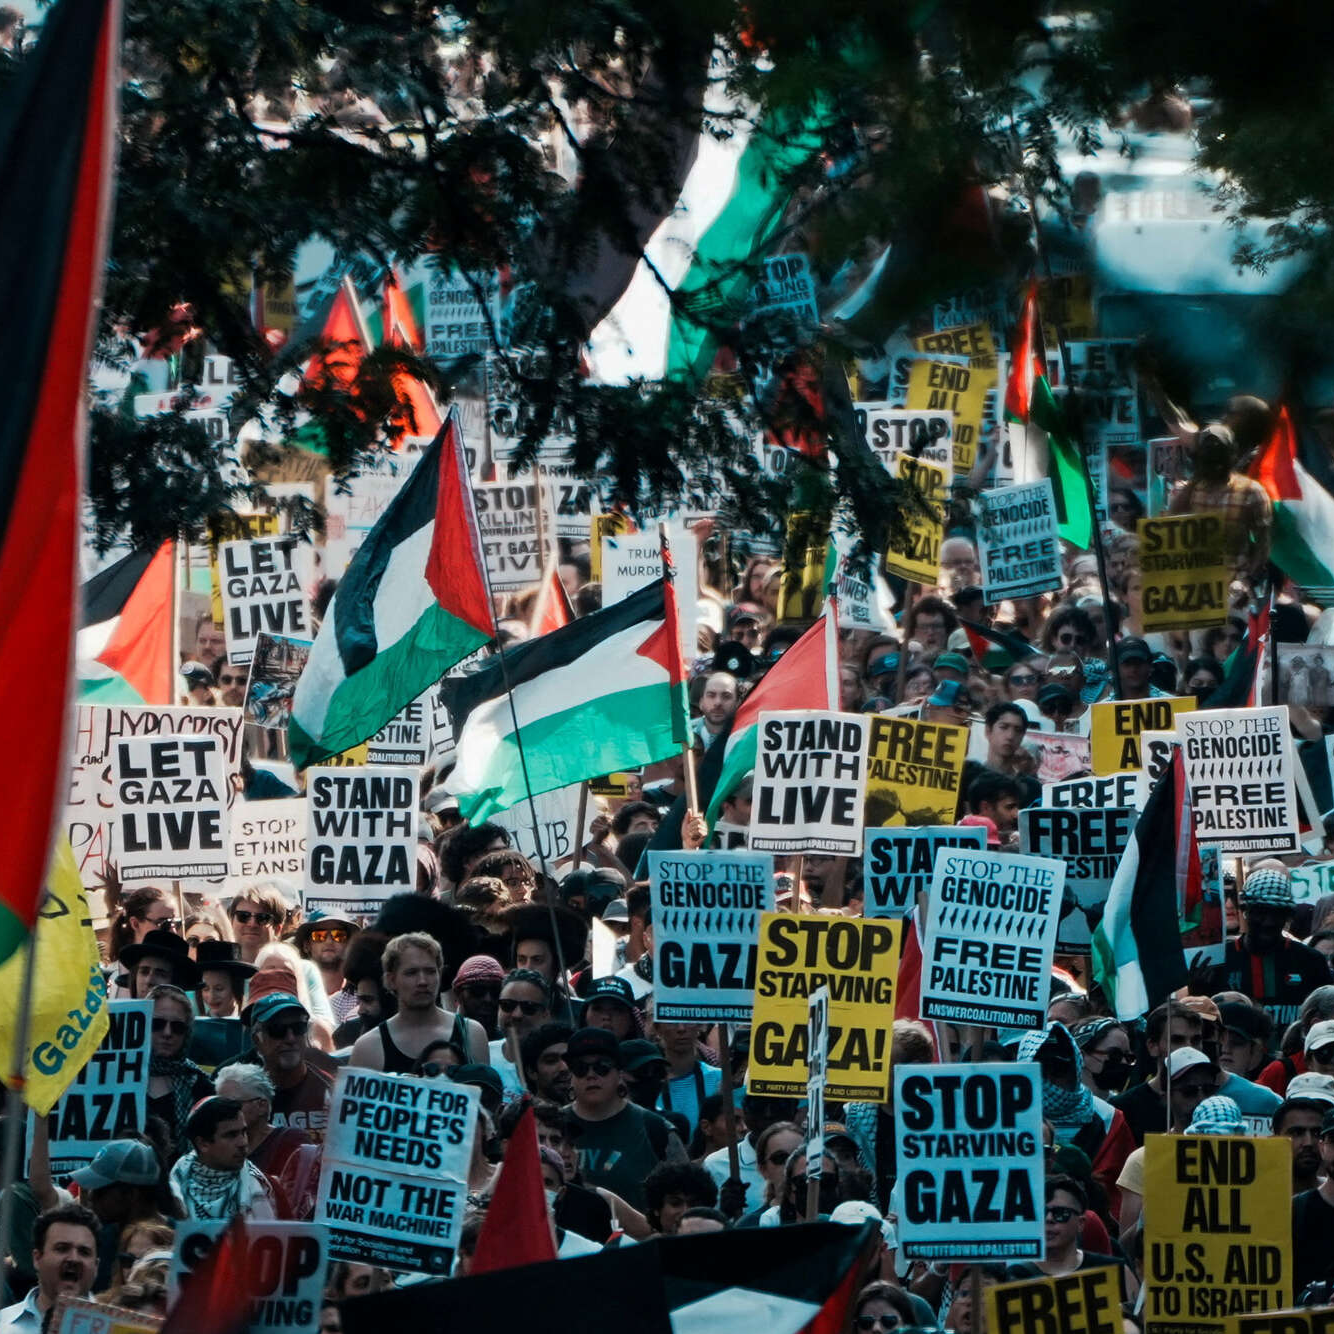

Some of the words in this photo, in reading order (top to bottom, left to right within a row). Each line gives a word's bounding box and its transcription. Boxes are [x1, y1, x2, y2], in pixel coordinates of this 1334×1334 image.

[929, 363, 970, 392] END
[872, 418, 947, 449] STOP
[983, 499, 1049, 528] GENOCIDE
[1143, 516, 1218, 551] STOP
[225, 542, 298, 576] LET
[987, 538, 1055, 566] FREE
[227, 574, 302, 598] GAZA
[988, 558, 1056, 585] PALESTINE
[1143, 584, 1225, 615] GAZA!
[230, 601, 305, 640] LIVE
[1115, 702, 1172, 735] END
[1186, 719, 1234, 736] STOP
[1240, 717, 1281, 733] THE
[763, 722, 863, 753] STAND
[872, 719, 957, 771] FREE
[1187, 733, 1282, 759] GENOCIDE
[118, 741, 216, 779] LET
[763, 752, 861, 780] WITH
[119, 780, 219, 804] GAZA
[313, 776, 413, 809] STAND
[759, 786, 857, 826] LIVE
[1191, 782, 1286, 807] FREE
[122, 811, 223, 852] LIVE
[242, 820, 296, 835] STOP
[313, 811, 412, 838] WITH
[1195, 807, 1288, 831] PALESTINE
[310, 845, 411, 885] GAZA
[659, 860, 713, 883] STOP
[720, 863, 765, 882] THE
[944, 858, 1003, 879] STOP
[1008, 865, 1054, 887] THE
[660, 882, 766, 908] GENOCIDE
[941, 876, 1051, 915] GENOCIDE
[767, 918, 893, 971] STOP
[933, 936, 1043, 973] FREE
[759, 971, 893, 1004] STARVING
[929, 966, 1041, 1002] PALESTINE
[927, 1004, 1039, 1027] ANSWERCOALITION.ORG
[754, 1021, 887, 1073] GAZA!
[344, 1075, 423, 1107] MONEY
[428, 1089, 469, 1116] FOR
[901, 1075, 1034, 1130] STOP
[339, 1099, 464, 1144] PEOPLE'S
[354, 1130, 442, 1170] NEEDS
[901, 1131, 1036, 1159] STARVING
[1175, 1139, 1255, 1186] END
[329, 1171, 391, 1208] NOT
[400, 1184, 456, 1219] THE
[903, 1168, 1037, 1225] GAZA
[1184, 1188, 1251, 1234] ALL
[326, 1202, 363, 1223] WAR
[369, 1210, 452, 1239] MACHINE!
[1151, 1244, 1215, 1284] U.S.
[1222, 1246, 1281, 1285] AID
[1149, 1287, 1183, 1318] TO
[1189, 1288, 1283, 1317] ISRAEL!
